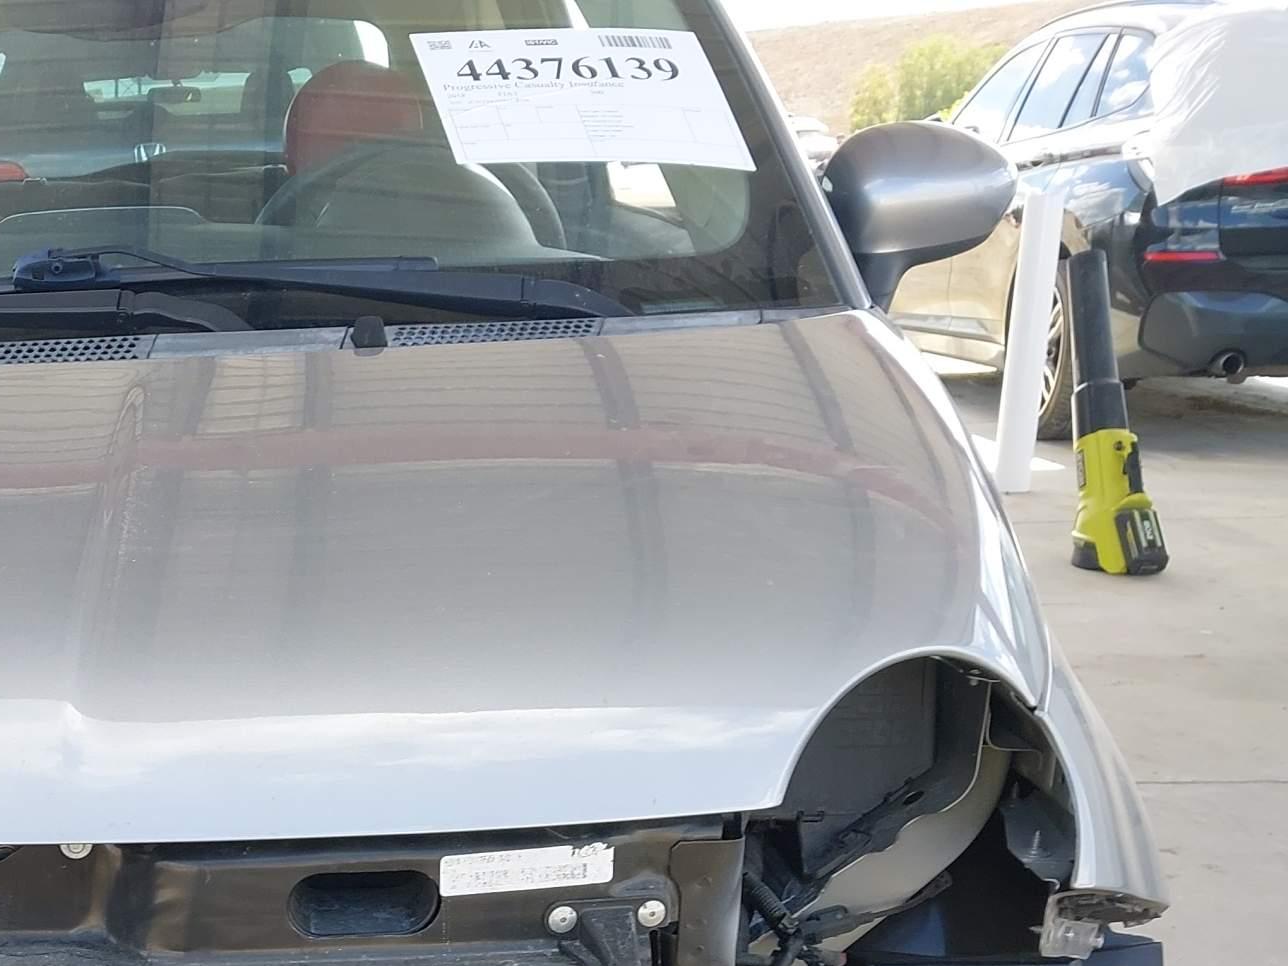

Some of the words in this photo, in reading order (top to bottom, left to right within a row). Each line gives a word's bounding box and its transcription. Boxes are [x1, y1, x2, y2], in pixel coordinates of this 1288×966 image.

[456, 56, 680, 82] 44376139
[442, 82, 512, 92] Progressive
[514, 80, 566, 90] Casualty
